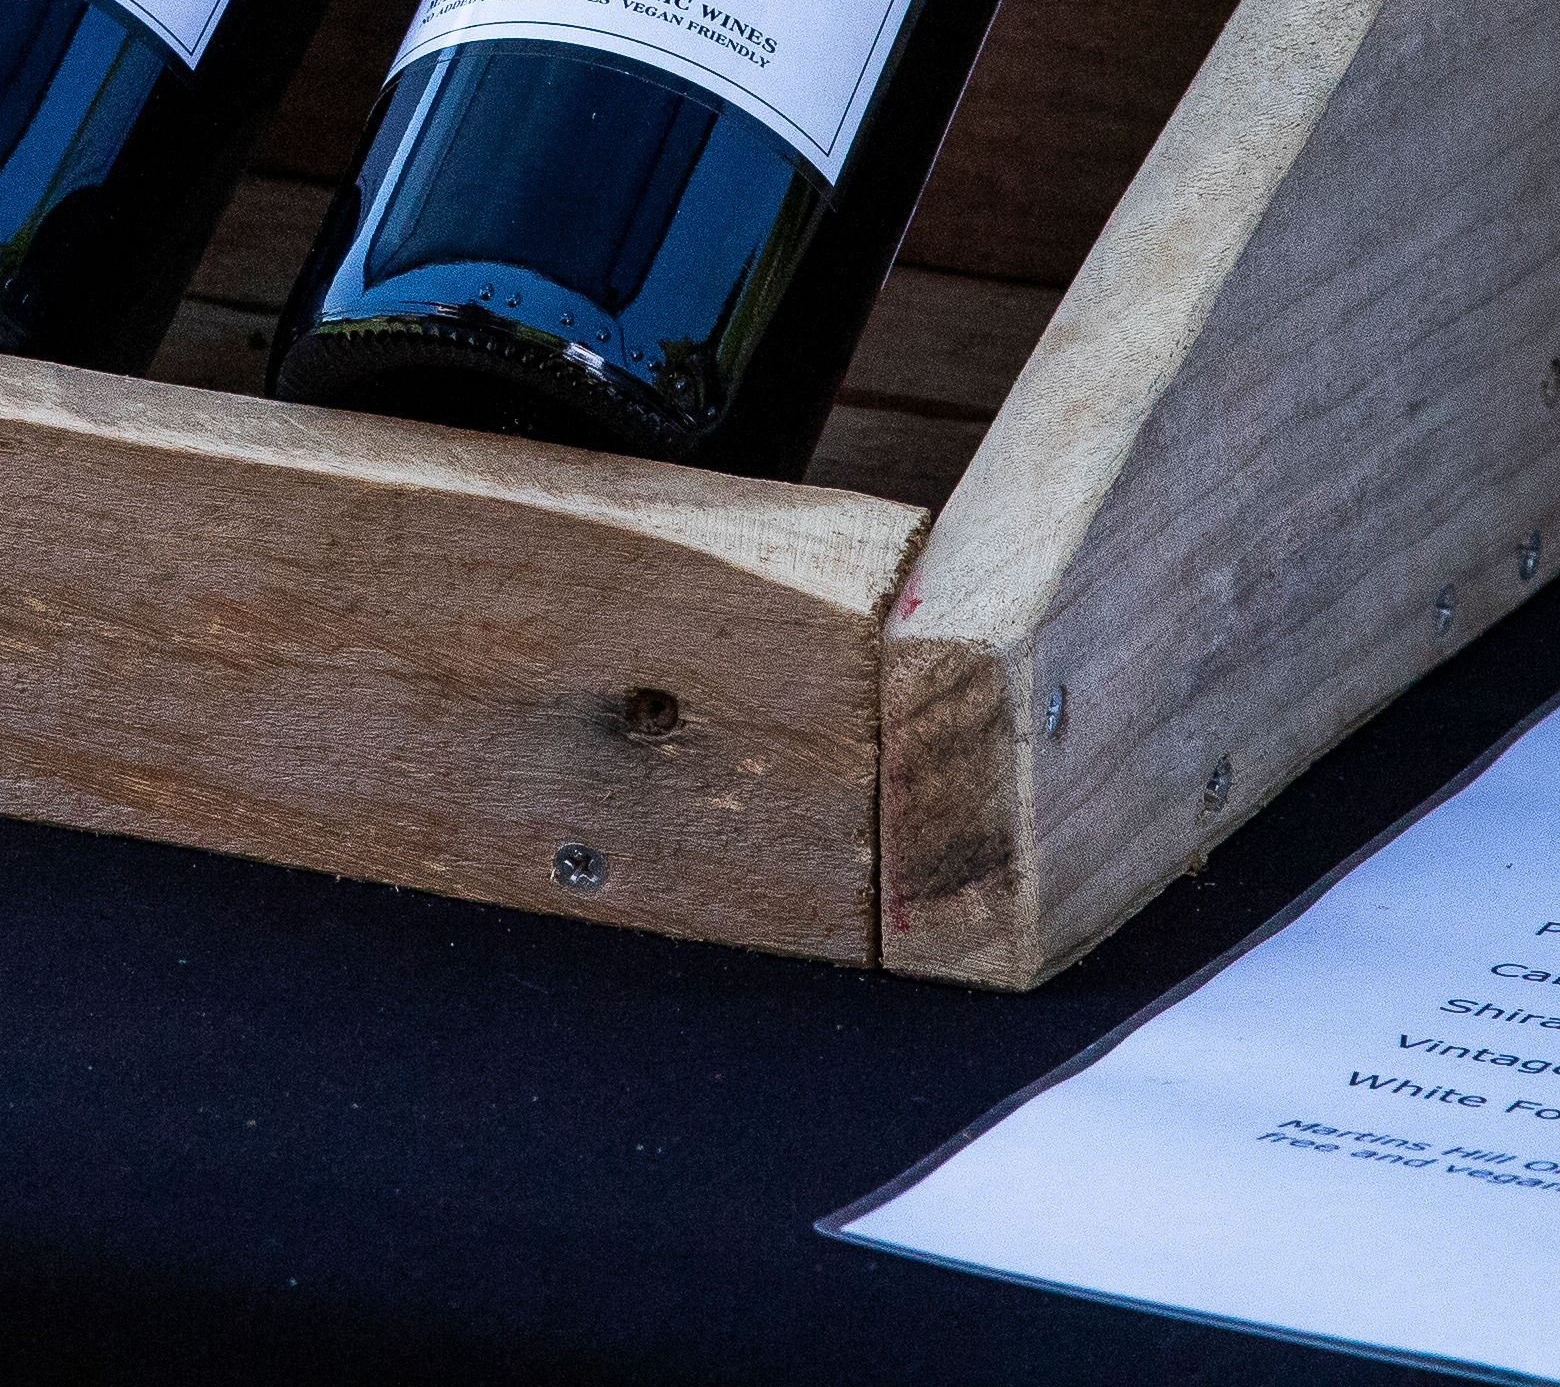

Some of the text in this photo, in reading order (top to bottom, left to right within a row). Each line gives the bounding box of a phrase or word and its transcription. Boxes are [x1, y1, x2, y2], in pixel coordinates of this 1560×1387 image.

[621, 0, 685, 27] VEGAN
[686, 19, 773, 71] FRIENDLY
[700, 2, 780, 55] WINES
[1347, 1070, 1489, 1110] White
[1254, 1130, 1342, 1153] free
[1349, 1145, 1439, 1169] and
[1276, 1117, 1433, 1153] Martins
[1440, 1145, 1520, 1166] Hill
